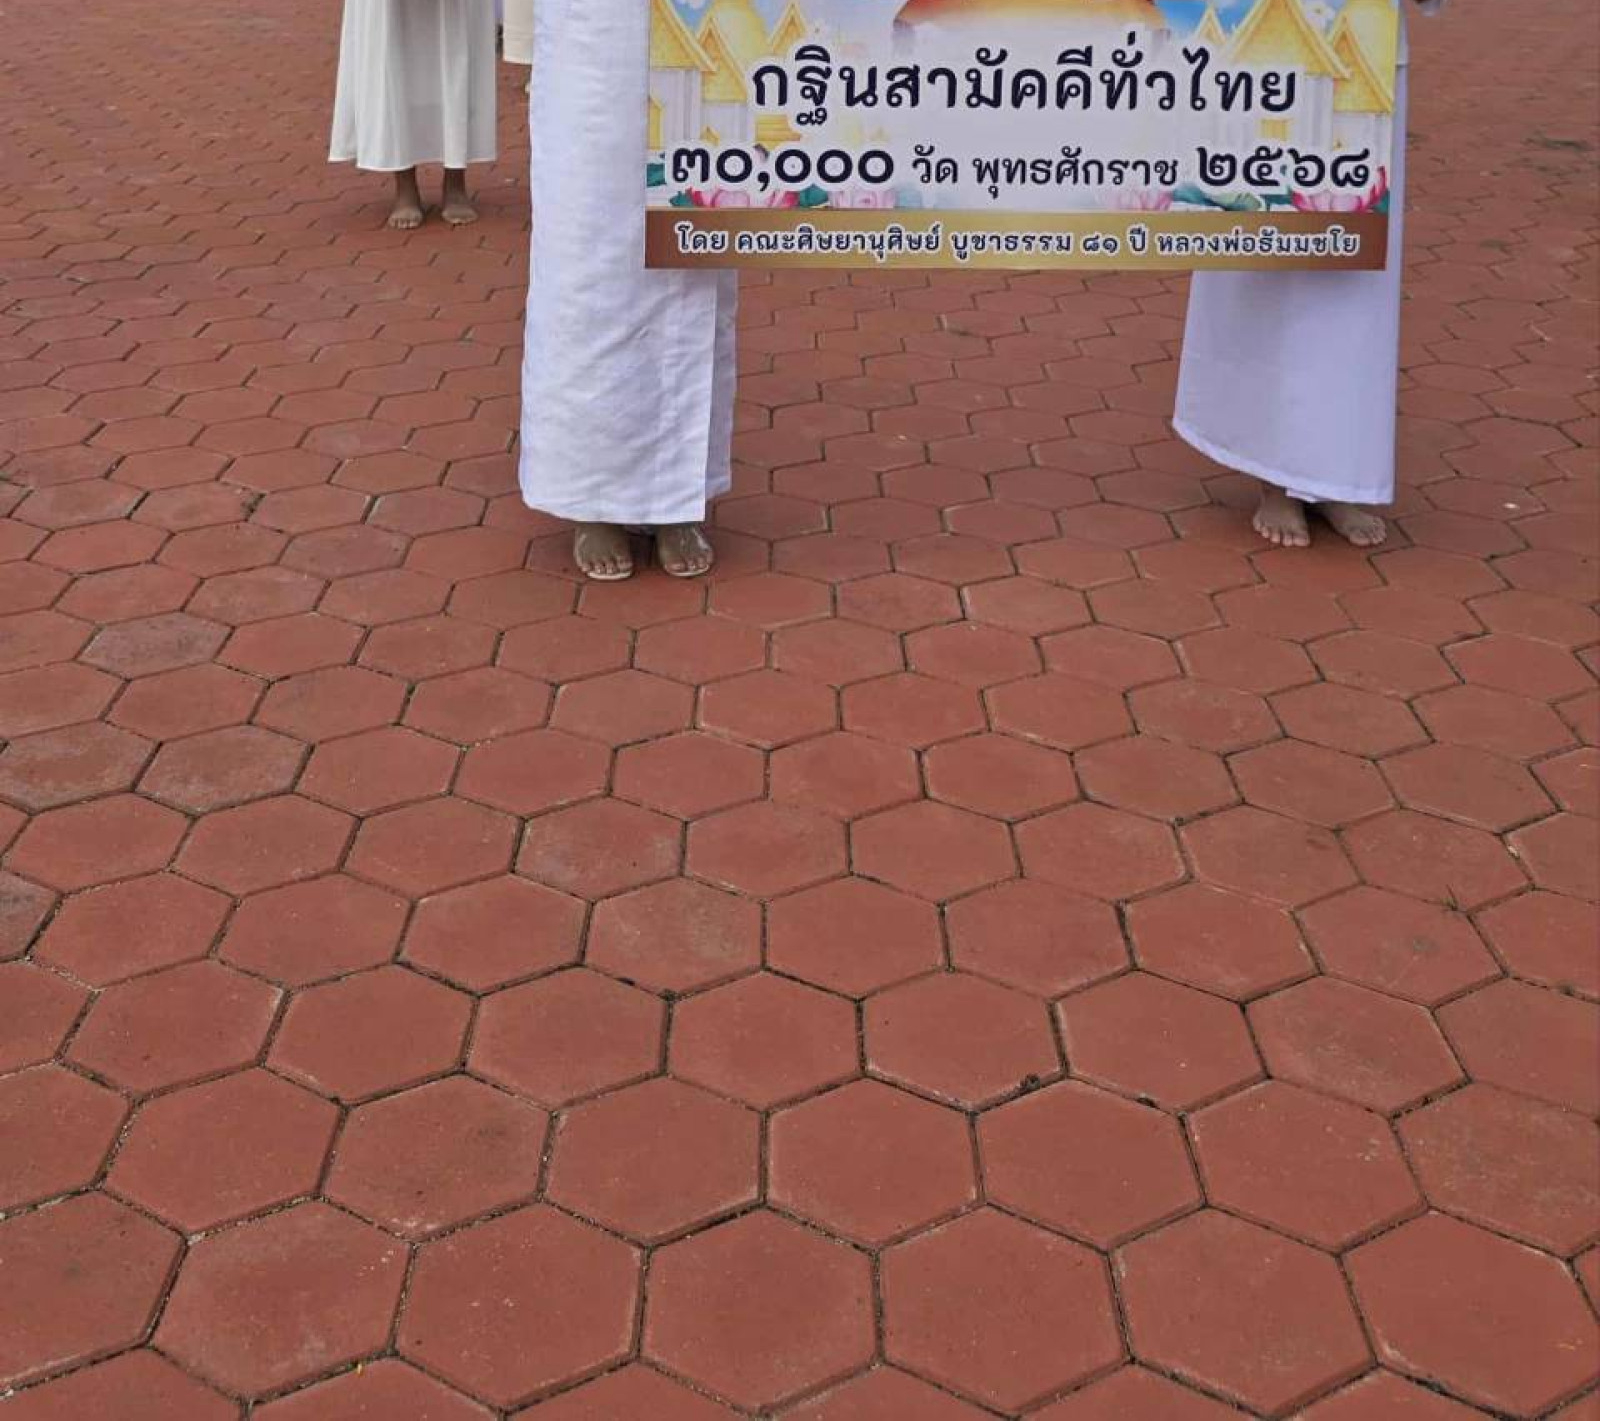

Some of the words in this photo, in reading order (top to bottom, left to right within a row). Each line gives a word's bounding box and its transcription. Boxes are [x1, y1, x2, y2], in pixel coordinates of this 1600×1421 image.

[753, 31, 1296, 126] กฐินสามัคคีทั่วไทย
[672, 146, 895, 191] ๓๐,๐๐๐
[912, 145, 959, 184] วัด
[973, 145, 1178, 199] พุทธศักราช
[1197, 145, 1371, 187] ๒๕๖๘
[677, 225, 727, 252] โดย
[737, 225, 940, 260] คณะศิษยานุศิษย์
[951, 232, 1071, 260] บูชาธรรม
[1082, 234, 1118, 253] ๘๑
[1129, 226, 1146, 253] ปี
[1157, 227, 1359, 255] หลวงพ่อธัมมชโย
